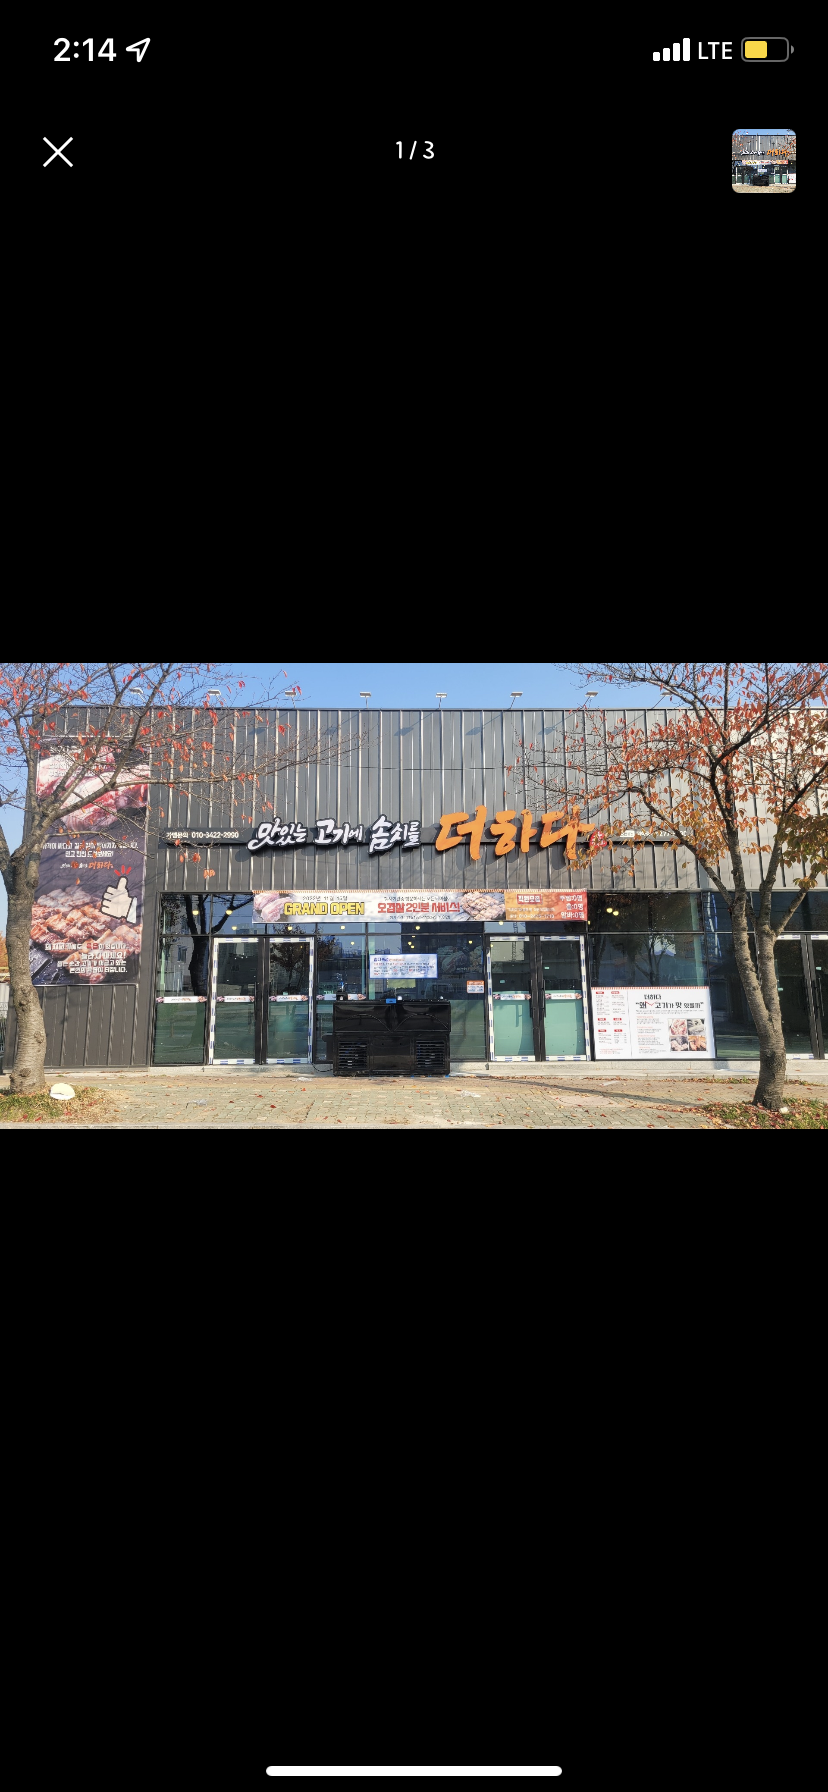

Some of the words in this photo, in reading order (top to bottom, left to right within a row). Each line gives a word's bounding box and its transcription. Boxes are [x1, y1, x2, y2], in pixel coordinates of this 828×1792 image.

[248, 818, 307, 850] 맛있는
[315, 819, 363, 845] 고기에
[435, 805, 595, 860] 더하다
[283, 902, 329, 916] GRAND
[331, 902, 365, 916] OPEN
[377, 902, 405, 914] 오겹살
[405, 902, 430, 913] 2인분
[431, 902, 461, 913] 서비스!
